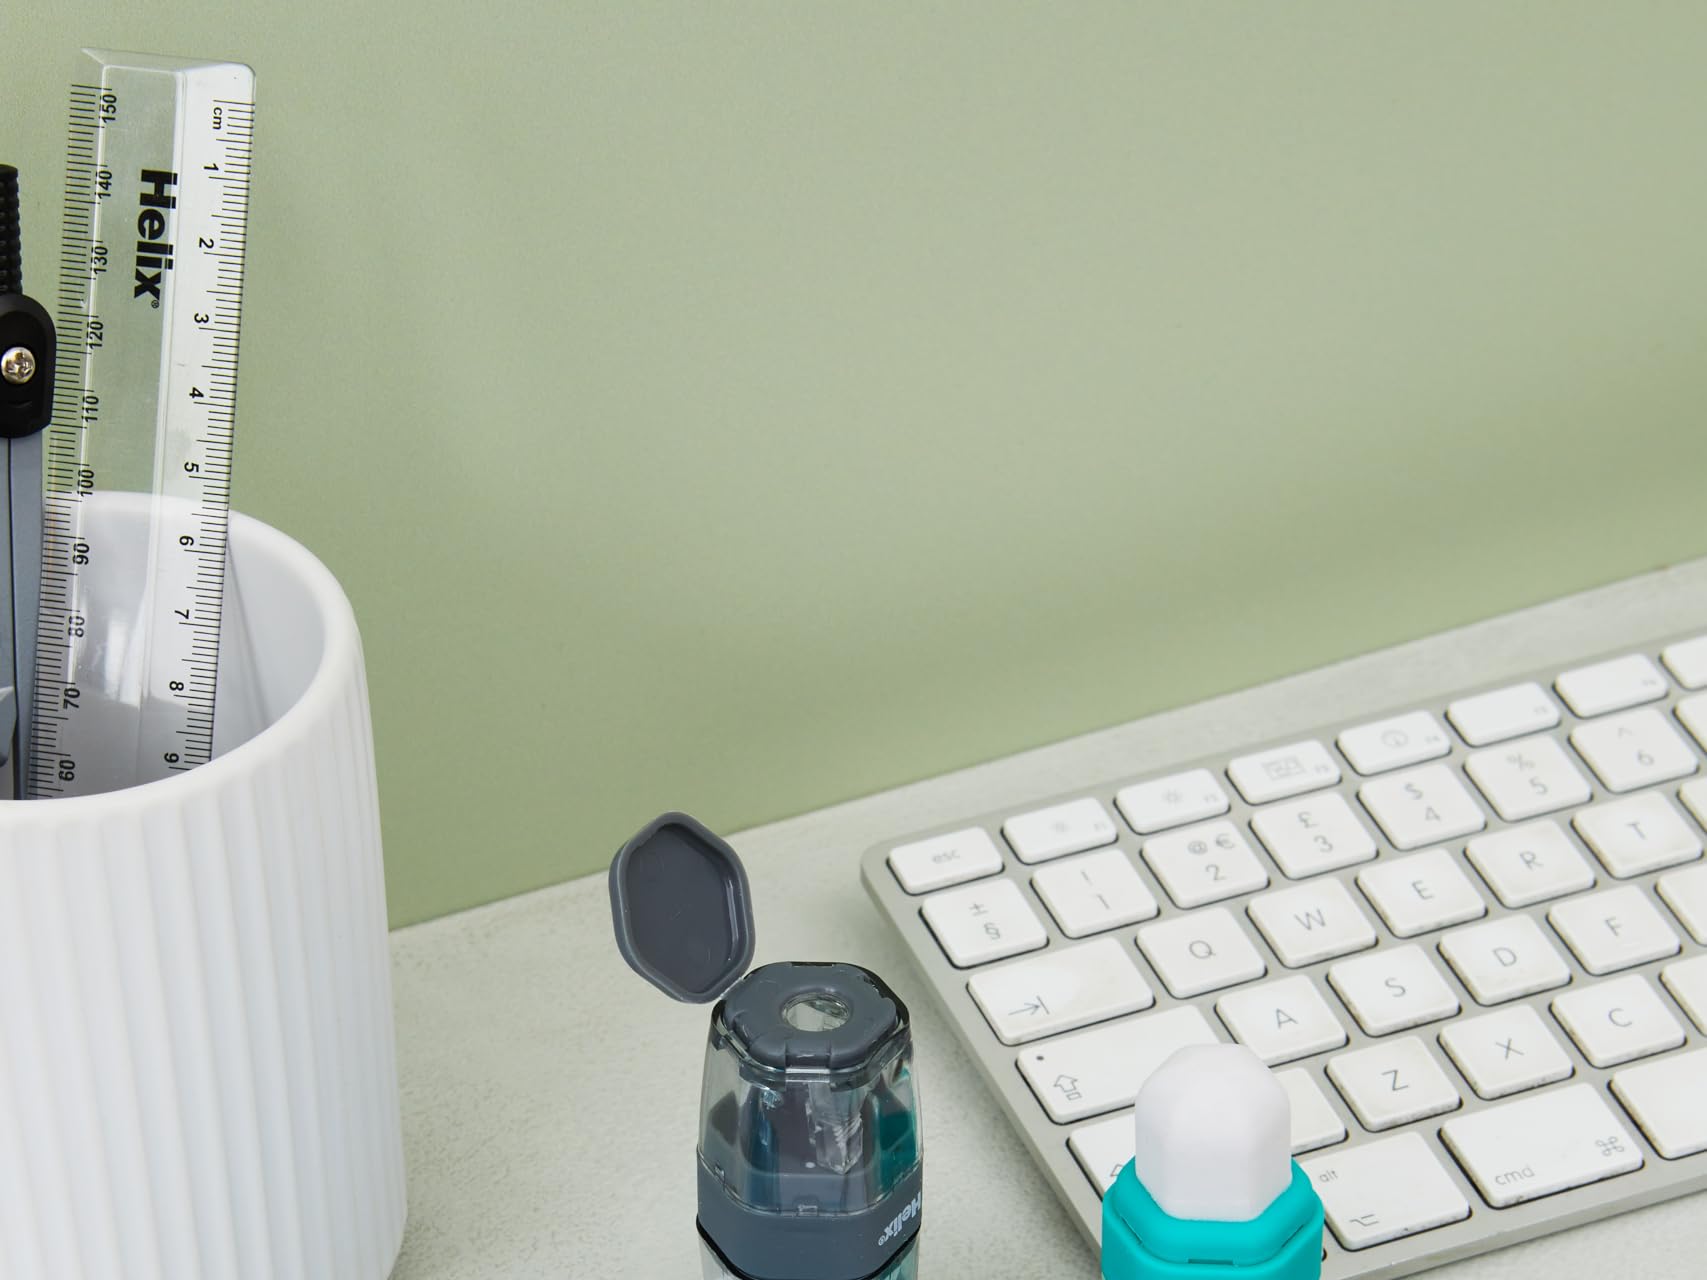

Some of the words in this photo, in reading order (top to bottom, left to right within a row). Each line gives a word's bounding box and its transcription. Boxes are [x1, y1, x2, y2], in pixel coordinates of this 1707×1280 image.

[98, 93, 118, 124] 150
[212, 106, 223, 130] cm
[203, 162, 219, 173] 1
[94, 169, 113, 199] 140
[198, 237, 215, 249] 2
[90, 245, 108, 275] 130
[194, 312, 210, 325] 3
[85, 320, 104, 349] 120
[189, 387, 204, 399] 4
[80, 395, 100, 423] 110
[184, 461, 200, 473] 5
[76, 469, 95, 498] 100
[179, 535, 195, 546] 6
[72, 542, 90, 566] 90
[174, 608, 190, 620] 7
[68, 615, 86, 638] 80
[169, 680, 185, 692] 8
[62, 687, 81, 710] 70
[164, 752, 180, 763] 9
[1636, 748, 1656, 768] 6
[58, 758, 76, 782] 60
[1528, 776, 1549, 796] 5
[1424, 804, 1443, 822] 4
[1624, 820, 1648, 842] T
[1312, 834, 1334, 853] 3
[1518, 849, 1545, 872] R
[1204, 863, 1229, 883] 2
[1410, 879, 1436, 902] E
[1292, 906, 1328, 933] W
[1604, 914, 1624, 938] F
[1187, 939, 1217, 960] Q
[1490, 946, 1519, 968] D
[1383, 976, 1408, 998] S
[1274, 1006, 1300, 1030] A
[1606, 1006, 1634, 1029] C
[1493, 1036, 1526, 1062] X
[1380, 1067, 1411, 1093] Z
[1317, 1167, 1340, 1184] alt
[1493, 1162, 1536, 1187] cmd
